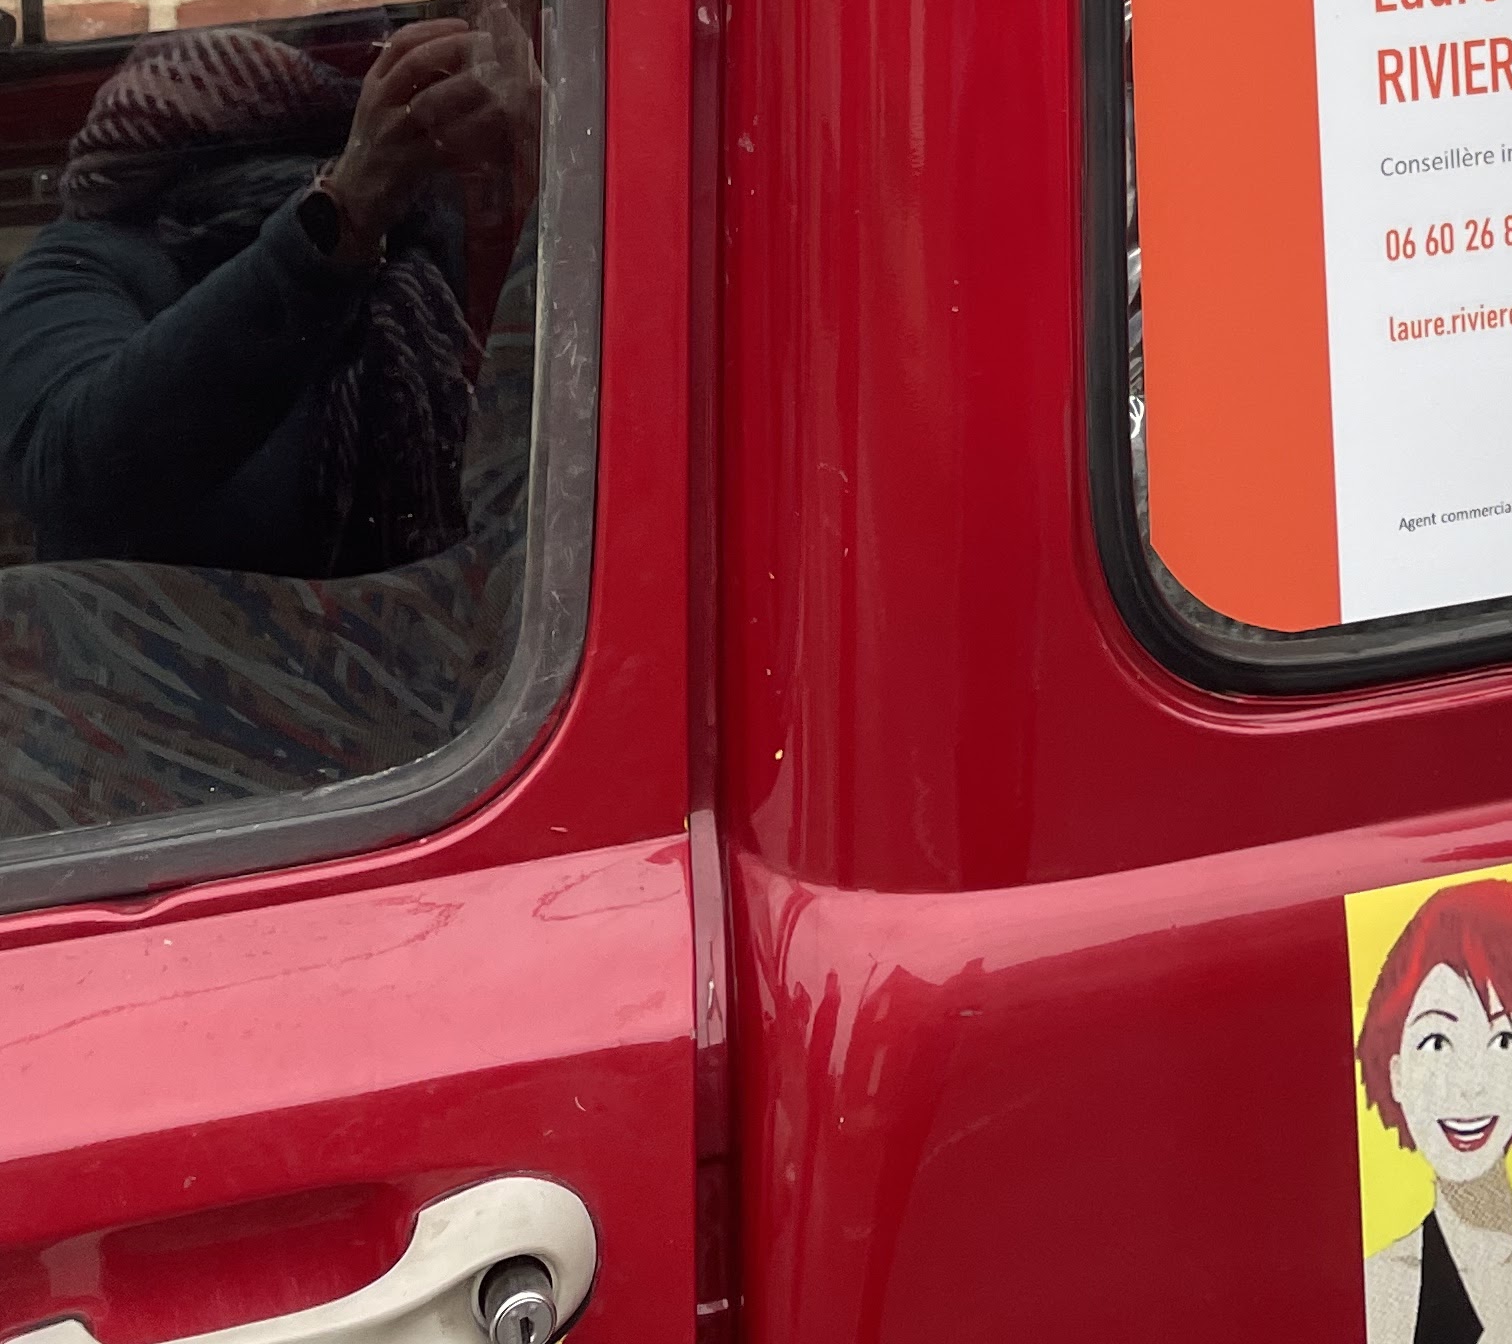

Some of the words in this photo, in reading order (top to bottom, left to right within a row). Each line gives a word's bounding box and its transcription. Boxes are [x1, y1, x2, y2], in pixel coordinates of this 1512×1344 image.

[1380, 146, 1496, 177] Conseillère
[1385, 226, 1417, 262] 06
[1425, 222, 1456, 257] 60
[1464, 217, 1495, 252] 26
[1398, 512, 1437, 532] Agent
